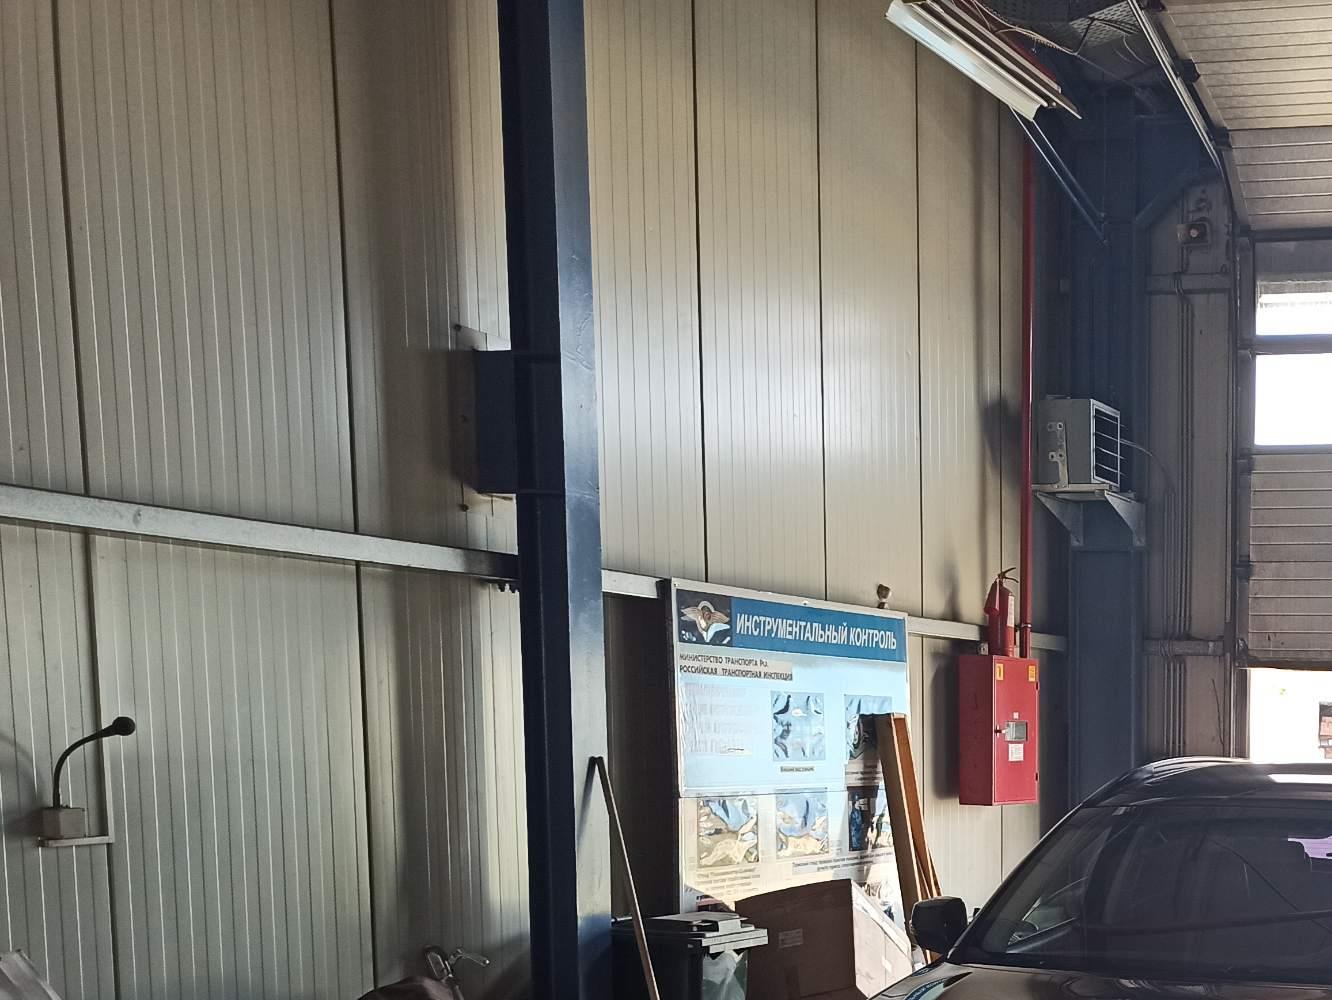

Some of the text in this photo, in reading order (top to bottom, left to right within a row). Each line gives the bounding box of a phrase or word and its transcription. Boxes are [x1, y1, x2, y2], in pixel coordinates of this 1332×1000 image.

[736, 613, 897, 650] ИНСТРУМЕНТАЛЬНЫЙ КОНТРОЛЬ
[679, 653, 723, 665] МИНИСТЕРСТВО
[724, 656, 758, 668] ТРАНСПОРТА
[679, 664, 793, 682] РОССИЙСКАЯ ТРАНСПОРТНАЯ ИНСПЕКЦИЯ
